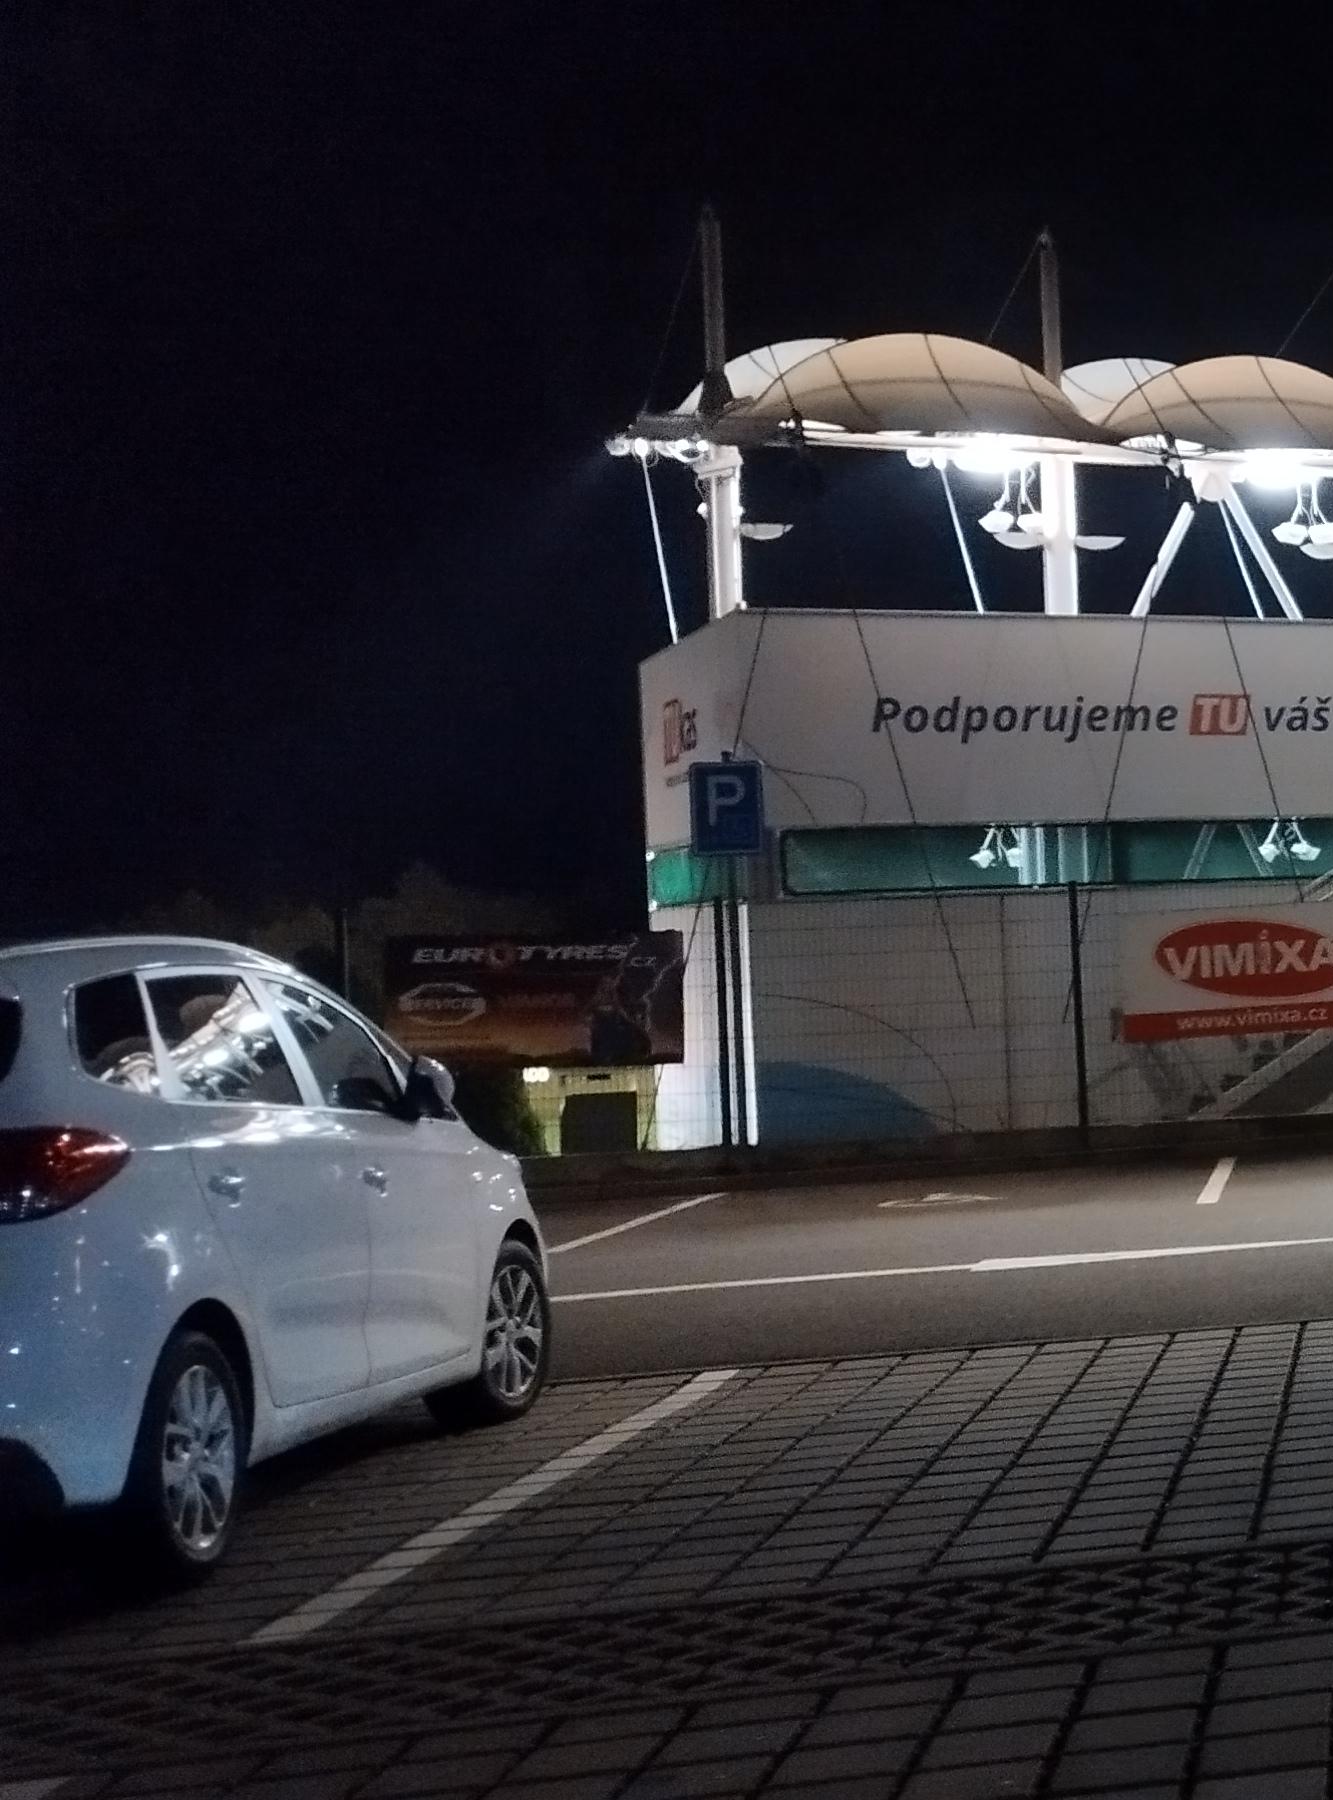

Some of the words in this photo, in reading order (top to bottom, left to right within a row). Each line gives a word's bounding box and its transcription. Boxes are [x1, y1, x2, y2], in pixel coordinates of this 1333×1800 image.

[872, 696, 1178, 743] Podporujeme
[1194, 696, 1248, 733] TU
[1264, 696, 1332, 732] váš
[706, 775, 746, 826] P
[1176, 1006, 1329, 1031] www.vimixa.cz
